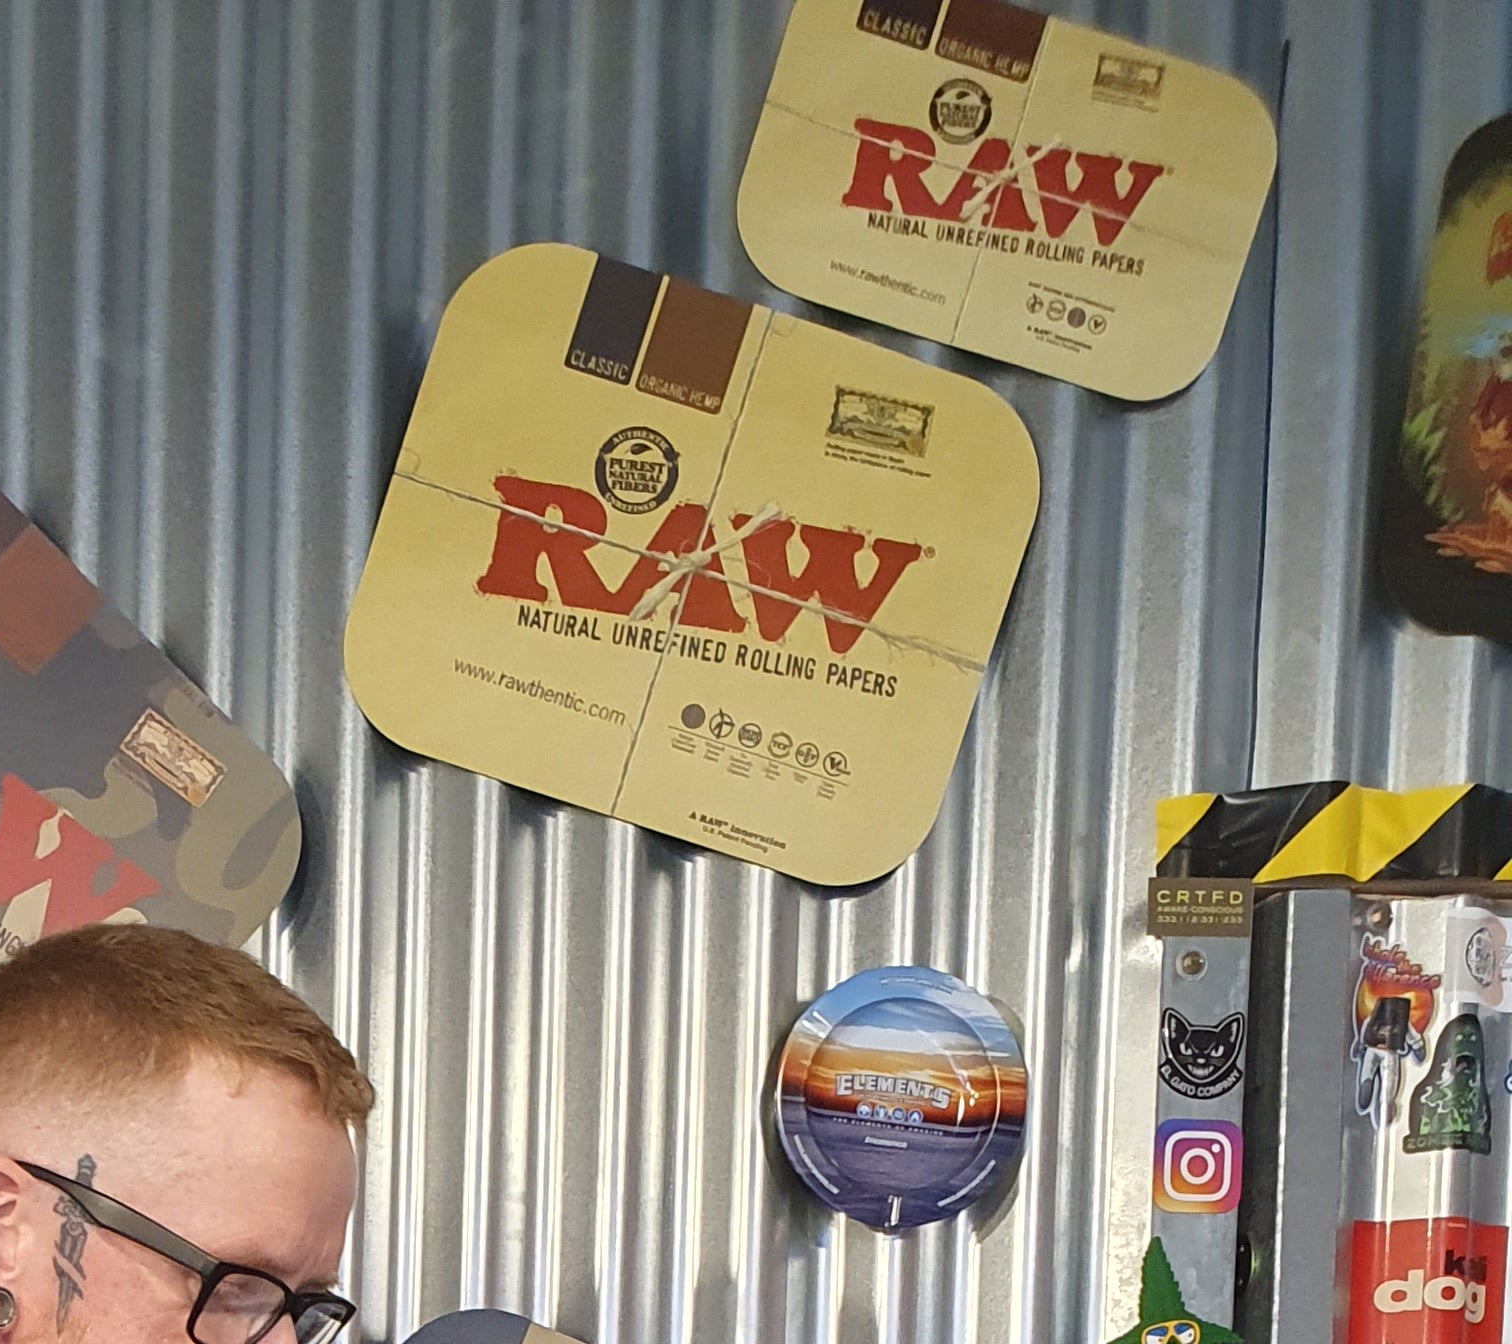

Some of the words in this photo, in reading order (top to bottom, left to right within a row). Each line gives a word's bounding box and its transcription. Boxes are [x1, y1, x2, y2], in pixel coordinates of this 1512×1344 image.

[863, 8, 929, 48] CLASSIC
[938, 36, 993, 67] ORGANIC
[841, 117, 1165, 248] RAW
[867, 211, 929, 242] NATURAL
[935, 223, 1020, 254] UNREFINED
[1025, 237, 1086, 266] ROLLING
[1091, 249, 1145, 278] PAPERS
[570, 347, 629, 382] CLASSIC
[638, 373, 688, 402] ORGANIC
[689, 387, 722, 411] HEMP
[609, 457, 667, 475] PUREST
[609, 470, 663, 484] NATURAL
[611, 479, 658, 494] FIBERS
[474, 473, 925, 656] RAW
[517, 602, 602, 642] NATURAL
[612, 620, 728, 666] UNREFINED
[735, 642, 817, 682] ROLLING
[826, 661, 899, 699] PAPERS
[452, 655, 629, 728] www.rawthentic.com
[1156, 889, 1244, 905] CRTFD
[835, 1073, 953, 1111] ELEMENTS
[1196, 1070, 1242, 1098] COMPANY
[1373, 1268, 1487, 1324] dog
